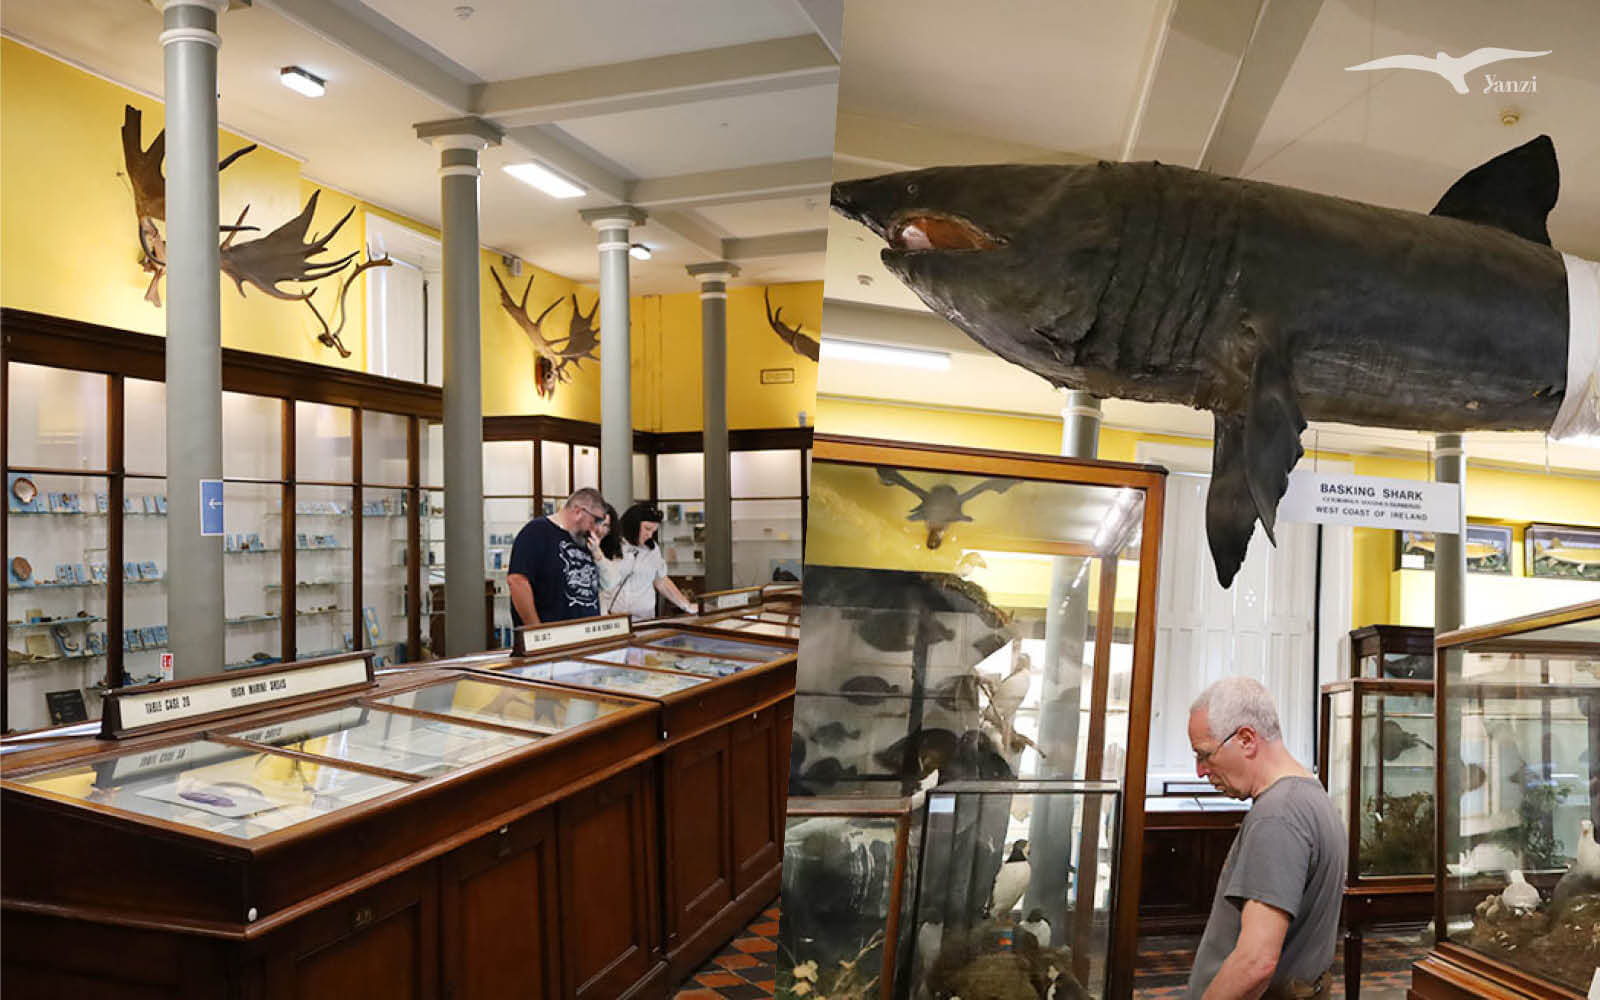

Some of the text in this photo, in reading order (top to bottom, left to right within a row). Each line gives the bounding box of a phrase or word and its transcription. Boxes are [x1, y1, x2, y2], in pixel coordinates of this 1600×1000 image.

[1320, 482, 1423, 501] BASKING SHARK
[1316, 505, 1428, 521] WEST COAST OF IRELAND
